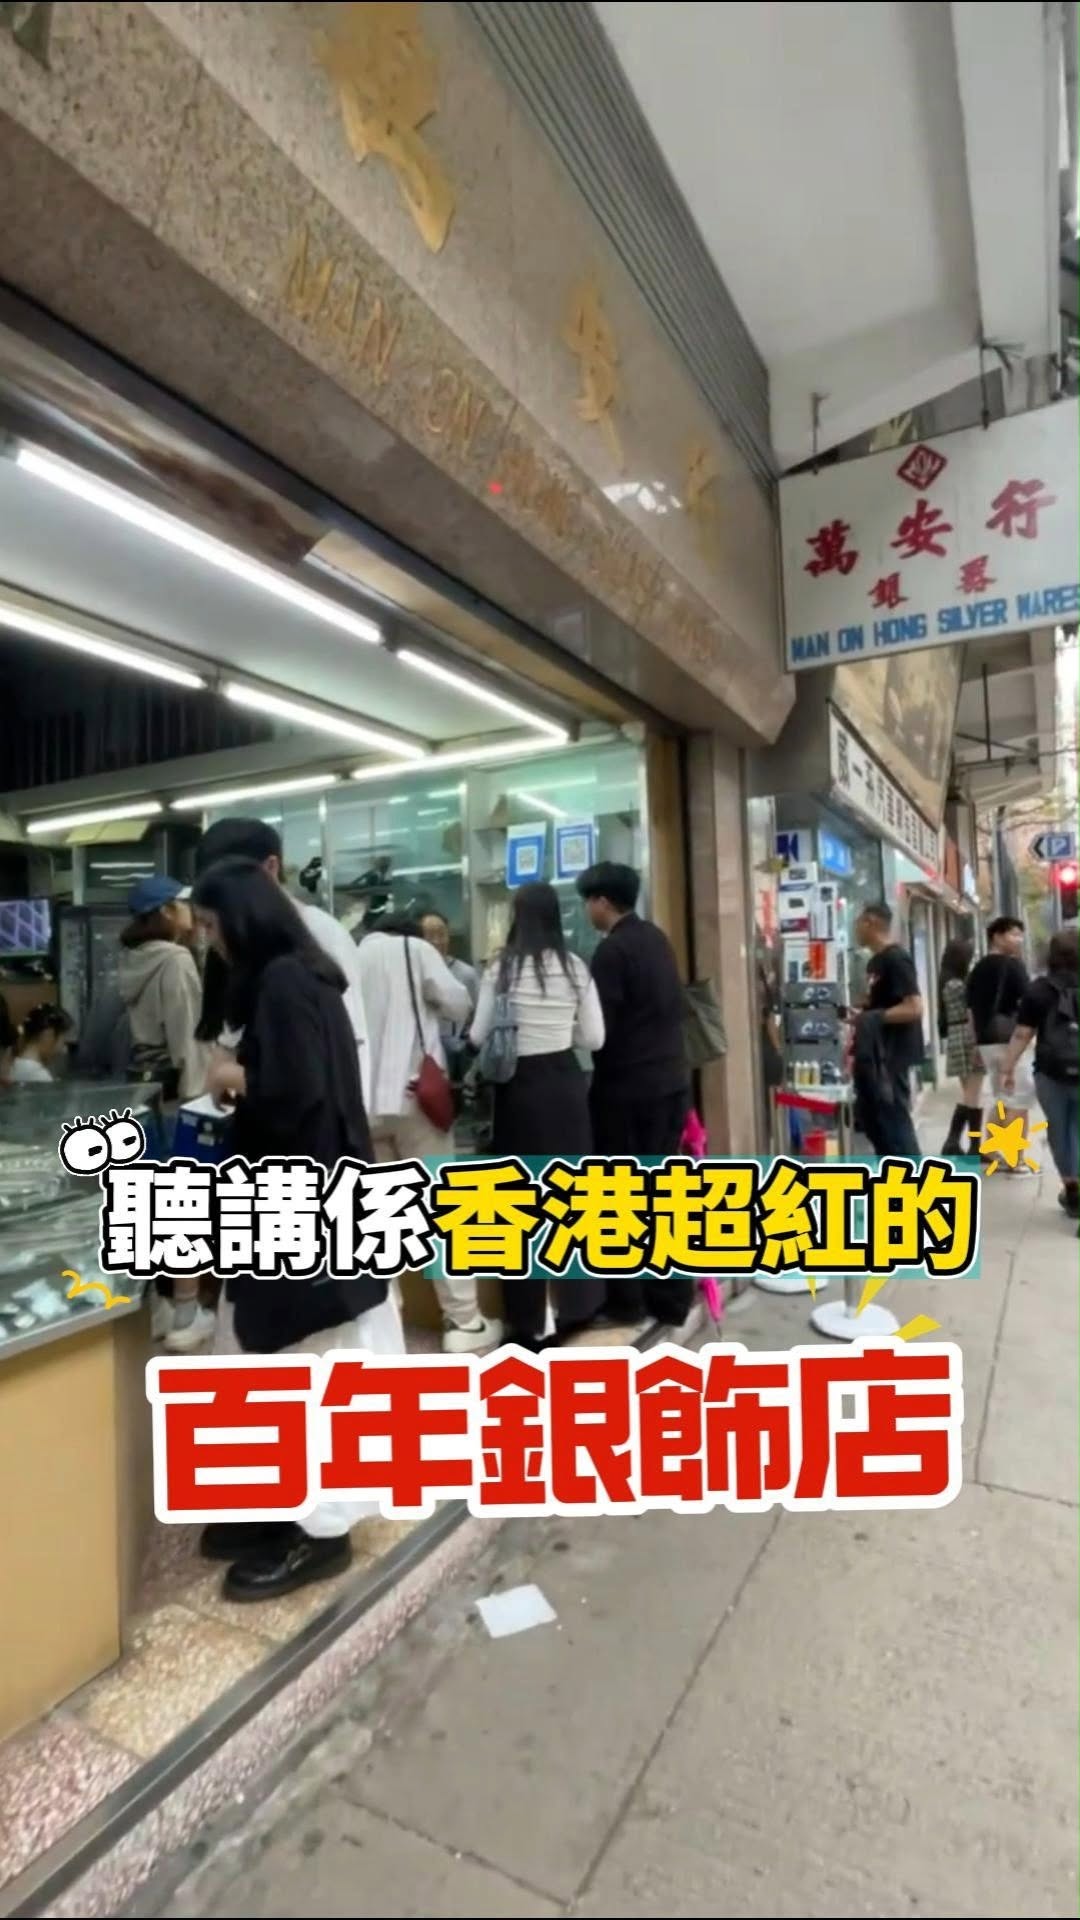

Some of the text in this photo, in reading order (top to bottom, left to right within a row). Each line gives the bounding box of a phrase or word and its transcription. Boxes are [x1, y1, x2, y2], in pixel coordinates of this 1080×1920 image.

[804, 479, 1056, 578] 萬安行
[791, 631, 830, 662] MAN
[838, 623, 864, 653] ON
[873, 612, 927, 647] HONG
[937, 598, 1008, 635] SILVER
